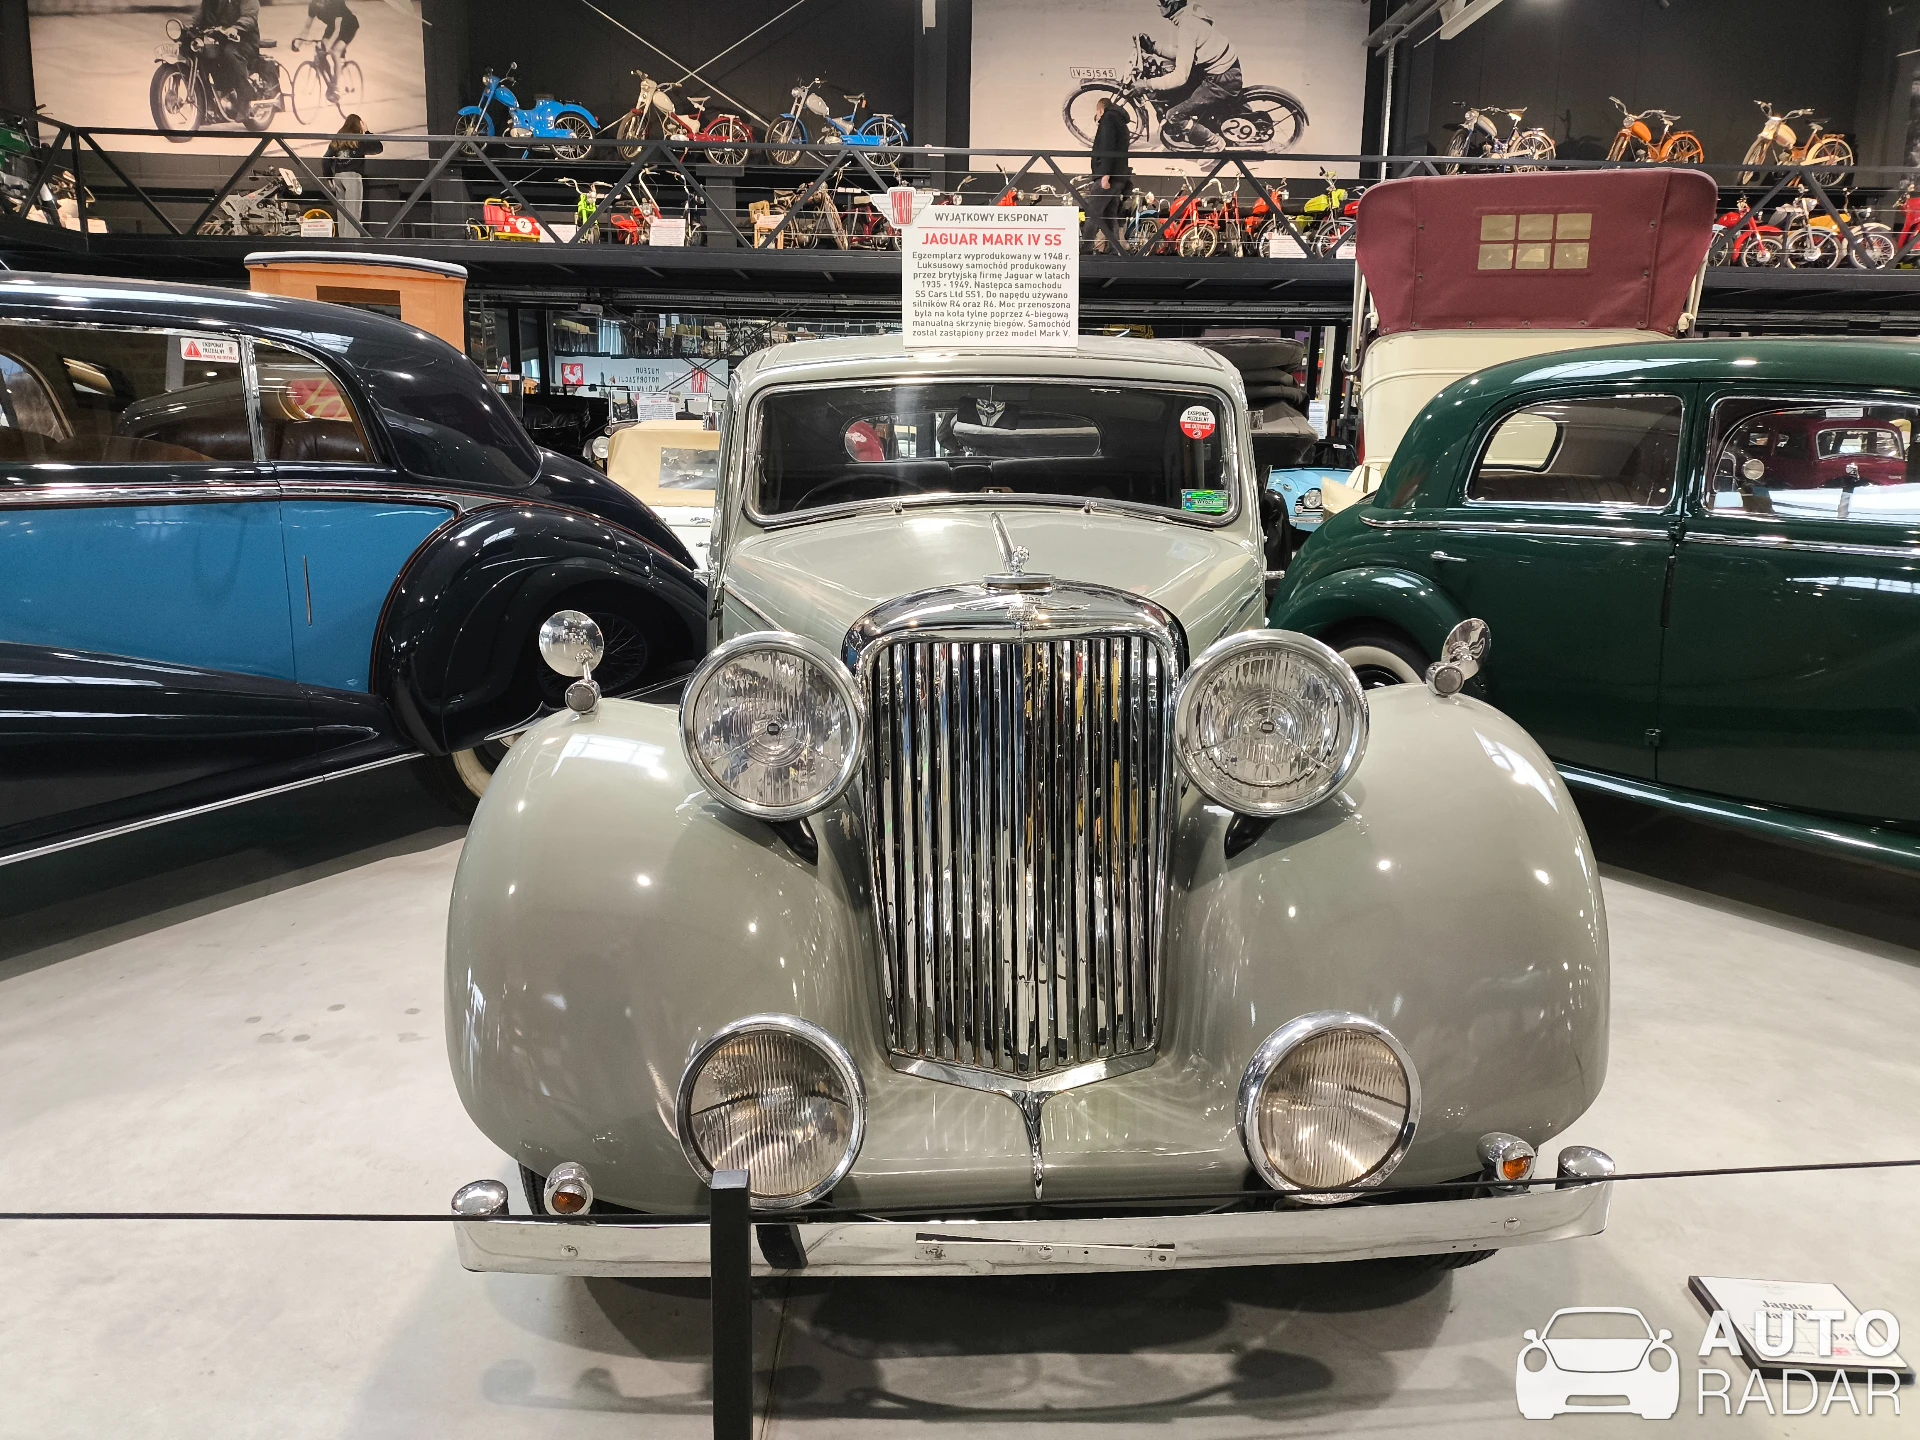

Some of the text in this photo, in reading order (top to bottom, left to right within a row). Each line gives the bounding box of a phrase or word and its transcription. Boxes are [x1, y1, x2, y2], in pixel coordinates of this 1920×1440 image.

[1224, 119, 1252, 140] 29
[935, 212, 1049, 224] WYJĄTKOWY EKSPONAT
[521, 221, 527, 229] 2
[922, 232, 1062, 246] JAGUAR MARK IV SS
[912, 251, 962, 262] Egzemplarz
[964, 252, 1032, 263] wyprodukowany
[1043, 252, 1063, 260] 1948
[917, 261, 1066, 271] Luksusowy samochód produkowany
[938, 271, 977, 281] brytyjską
[979, 271, 1002, 280] firmę
[1004, 272, 1033, 281] Jaguar
[1044, 272, 1070, 280] latach
[949, 281, 972, 289] 1949.
[974, 281, 1013, 290] Następca
[1014, 281, 1062, 289] samochodu
[999, 291, 1030, 300] napędu
[1032, 291, 1068, 300] używano
[912, 300, 947, 308] silników
[949, 300, 960, 308] R4
[983, 300, 997, 308] R6.
[1018, 302, 1071, 310] przenoszona
[967, 310, 988, 319] tylne
[990, 311, 1023, 319] poprzez
[1025, 310, 1069, 320] 4-biegową
[912, 320, 954, 328] manualną
[993, 320, 1026, 329] biegów.
[1028, 319, 1071, 328] Samochód
[939, 330, 984, 339] zastąpiony
[986, 330, 1009, 338] przez
[1762, 1300, 1813, 1311] Jaguar
